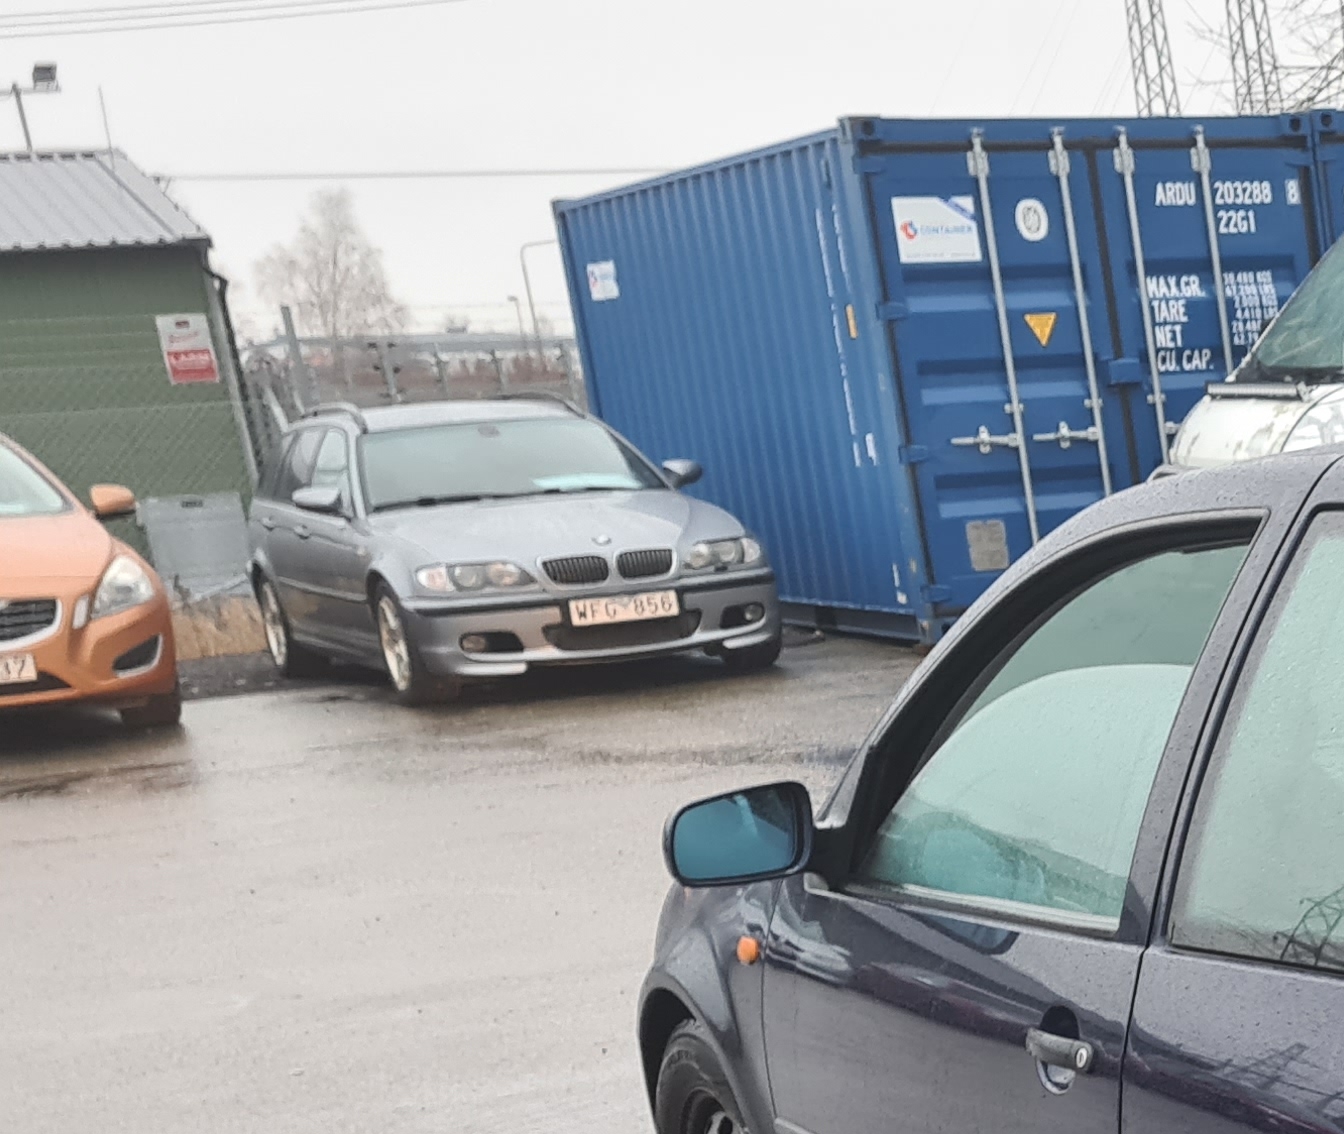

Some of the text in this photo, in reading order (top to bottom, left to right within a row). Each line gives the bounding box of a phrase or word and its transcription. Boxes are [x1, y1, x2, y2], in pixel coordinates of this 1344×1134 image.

[1155, 179, 1300, 206] ARDU 203288 8
[1217, 210, 1256, 234] 22G1
[1146, 274, 1206, 298] MAX.GR.
[1152, 299, 1188, 323] TARE
[1155, 324, 1183, 348] NET
[1157, 348, 1215, 373] CU. CAP.
